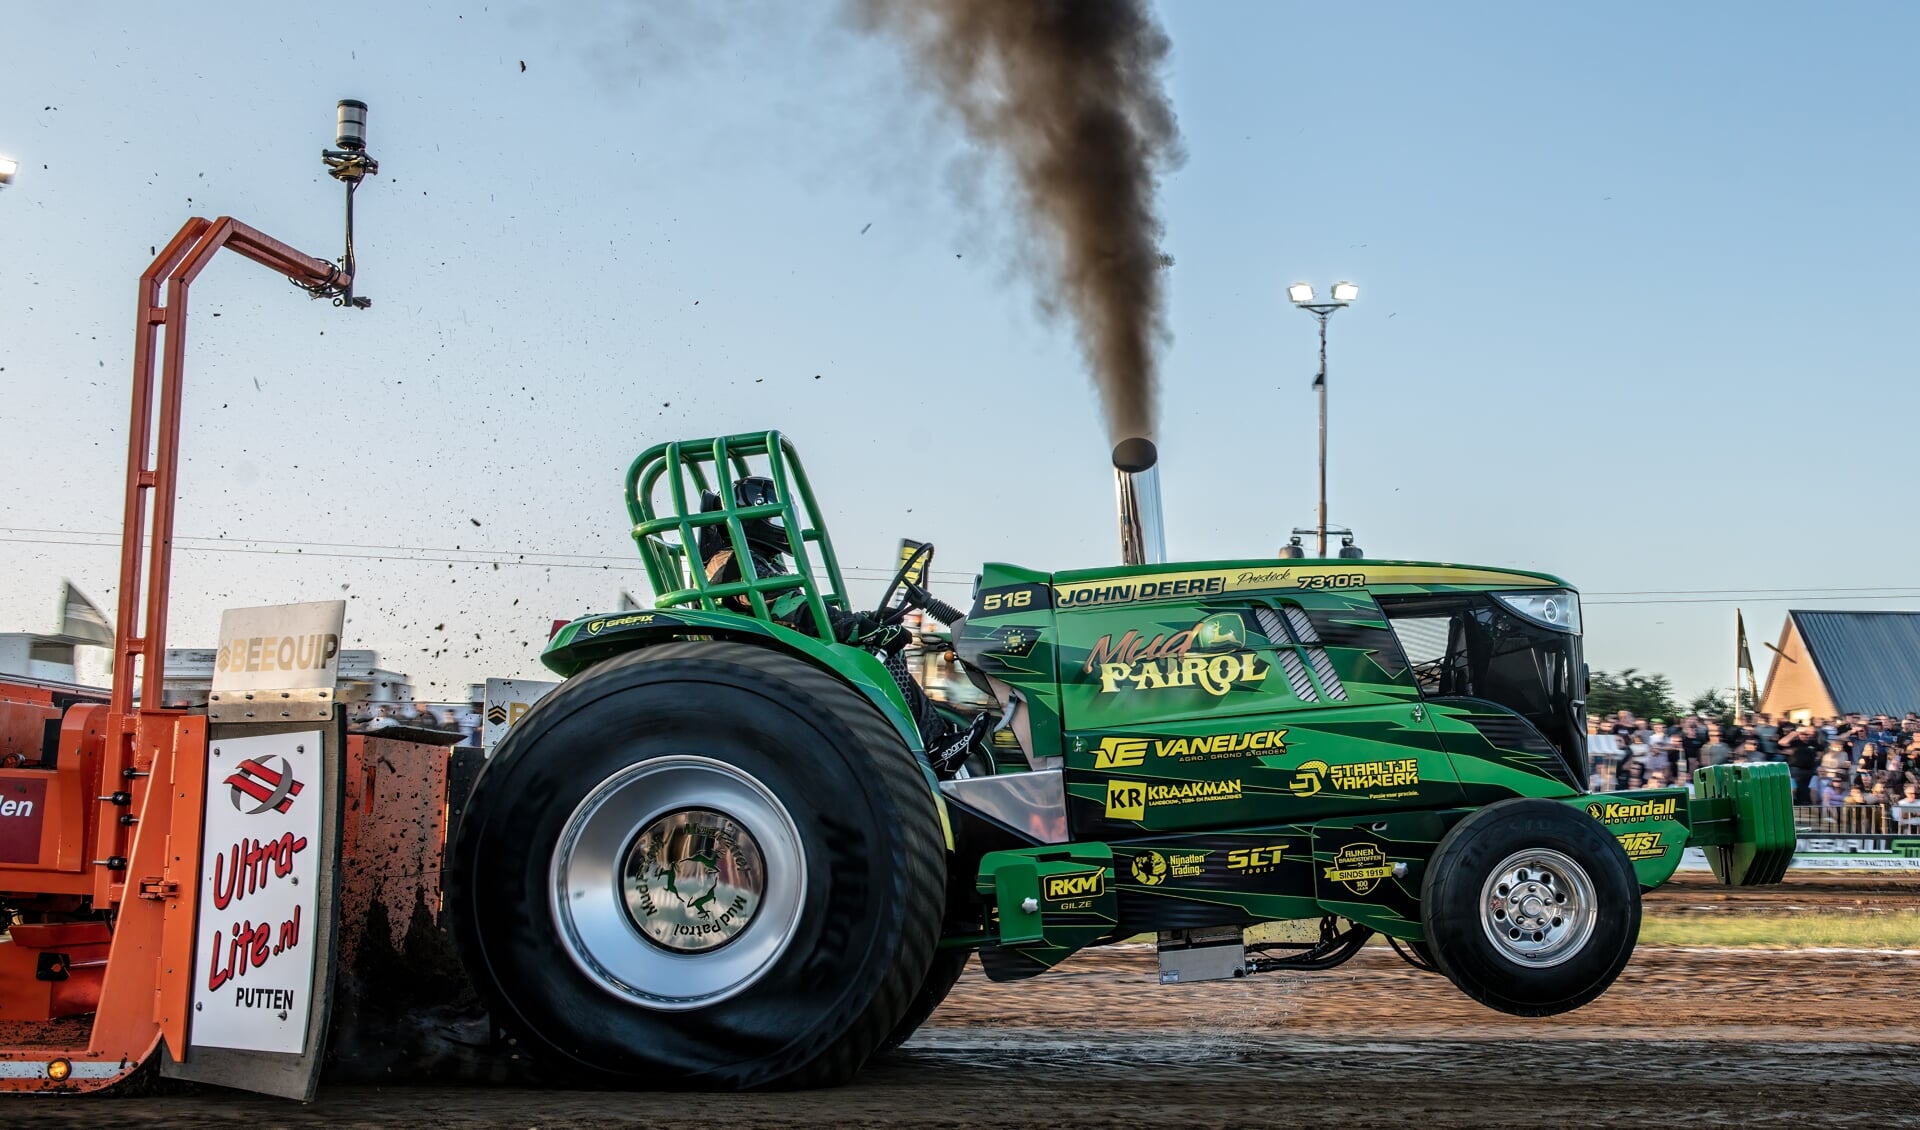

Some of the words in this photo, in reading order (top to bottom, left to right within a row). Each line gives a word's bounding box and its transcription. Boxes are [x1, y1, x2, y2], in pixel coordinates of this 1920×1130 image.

[1061, 584, 1133, 605] JOHN
[1139, 577, 1222, 600] DEERE
[1299, 575, 1365, 590] 7310R
[983, 590, 1032, 611] 518
[230, 633, 339, 673] BEEQUIP
[1083, 622, 1205, 673] Mud
[1210, 751, 1242, 760] GROND
[1255, 748, 1286, 756] GROEN
[1330, 759, 1417, 778] STAALTJE
[1147, 779, 1242, 800] KRAAKMAN
[1331, 772, 1419, 790] VAKWERK
[1110, 787, 1143, 809] KR
[1605, 799, 1676, 819] Kendall
[1604, 817, 1646, 825] MOTOR
[213, 831, 308, 910] Ultra-
[1169, 855, 1205, 867] Nijnatten
[1171, 865, 1200, 876] Trading
[1241, 866, 1275, 876] TOOLS
[1339, 870, 1364, 880] SINDS
[1366, 868, 1384, 877] 1919
[1050, 875, 1097, 897] RKM
[1356, 880, 1369, 888] 100
[720, 895, 747, 926] Mud
[1060, 900, 1093, 910] GILZE
[673, 919, 721, 937] Patrol
[208, 904, 301, 992] Lite.nl
[235, 987, 294, 1010] PUTTEN
